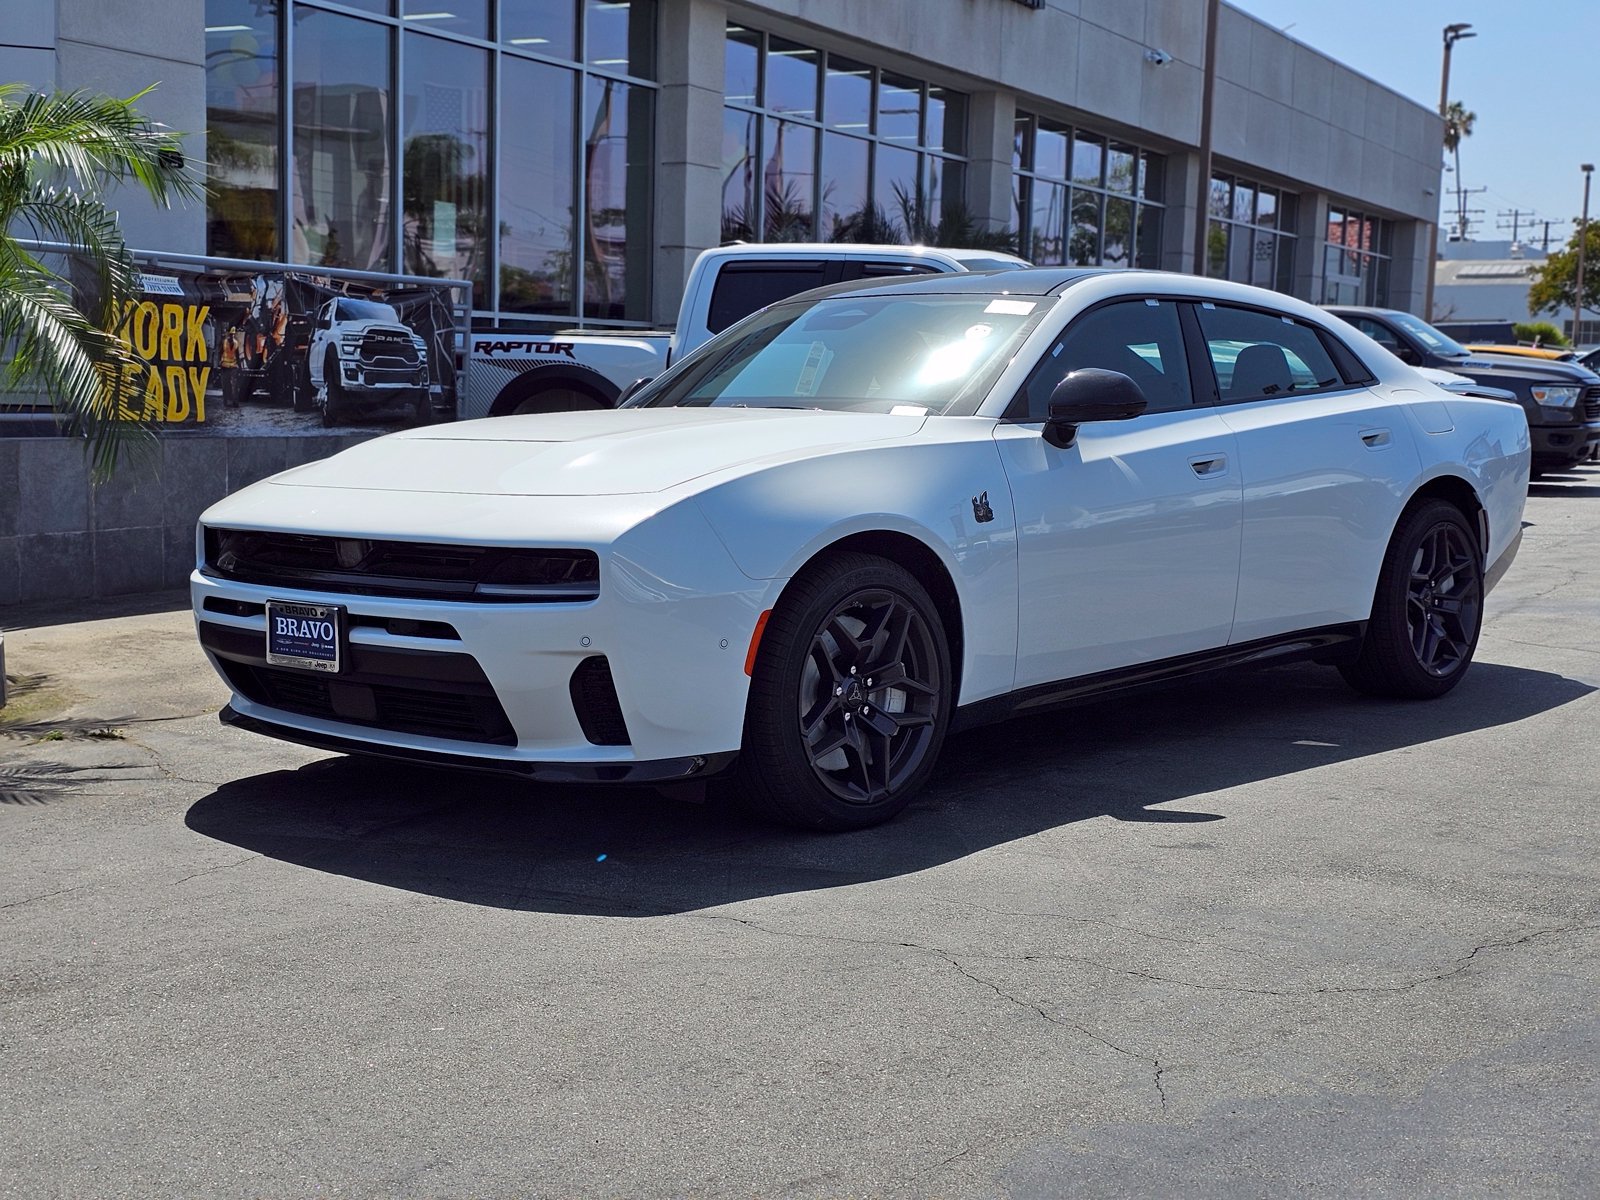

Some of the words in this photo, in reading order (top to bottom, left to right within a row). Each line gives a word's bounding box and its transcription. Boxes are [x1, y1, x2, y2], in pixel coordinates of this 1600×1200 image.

[474, 341, 576, 360] RAPTOR
[285, 605, 318, 617] BRAVO
[276, 617, 334, 641] BRAVO
[314, 661, 328, 669] Jeep
